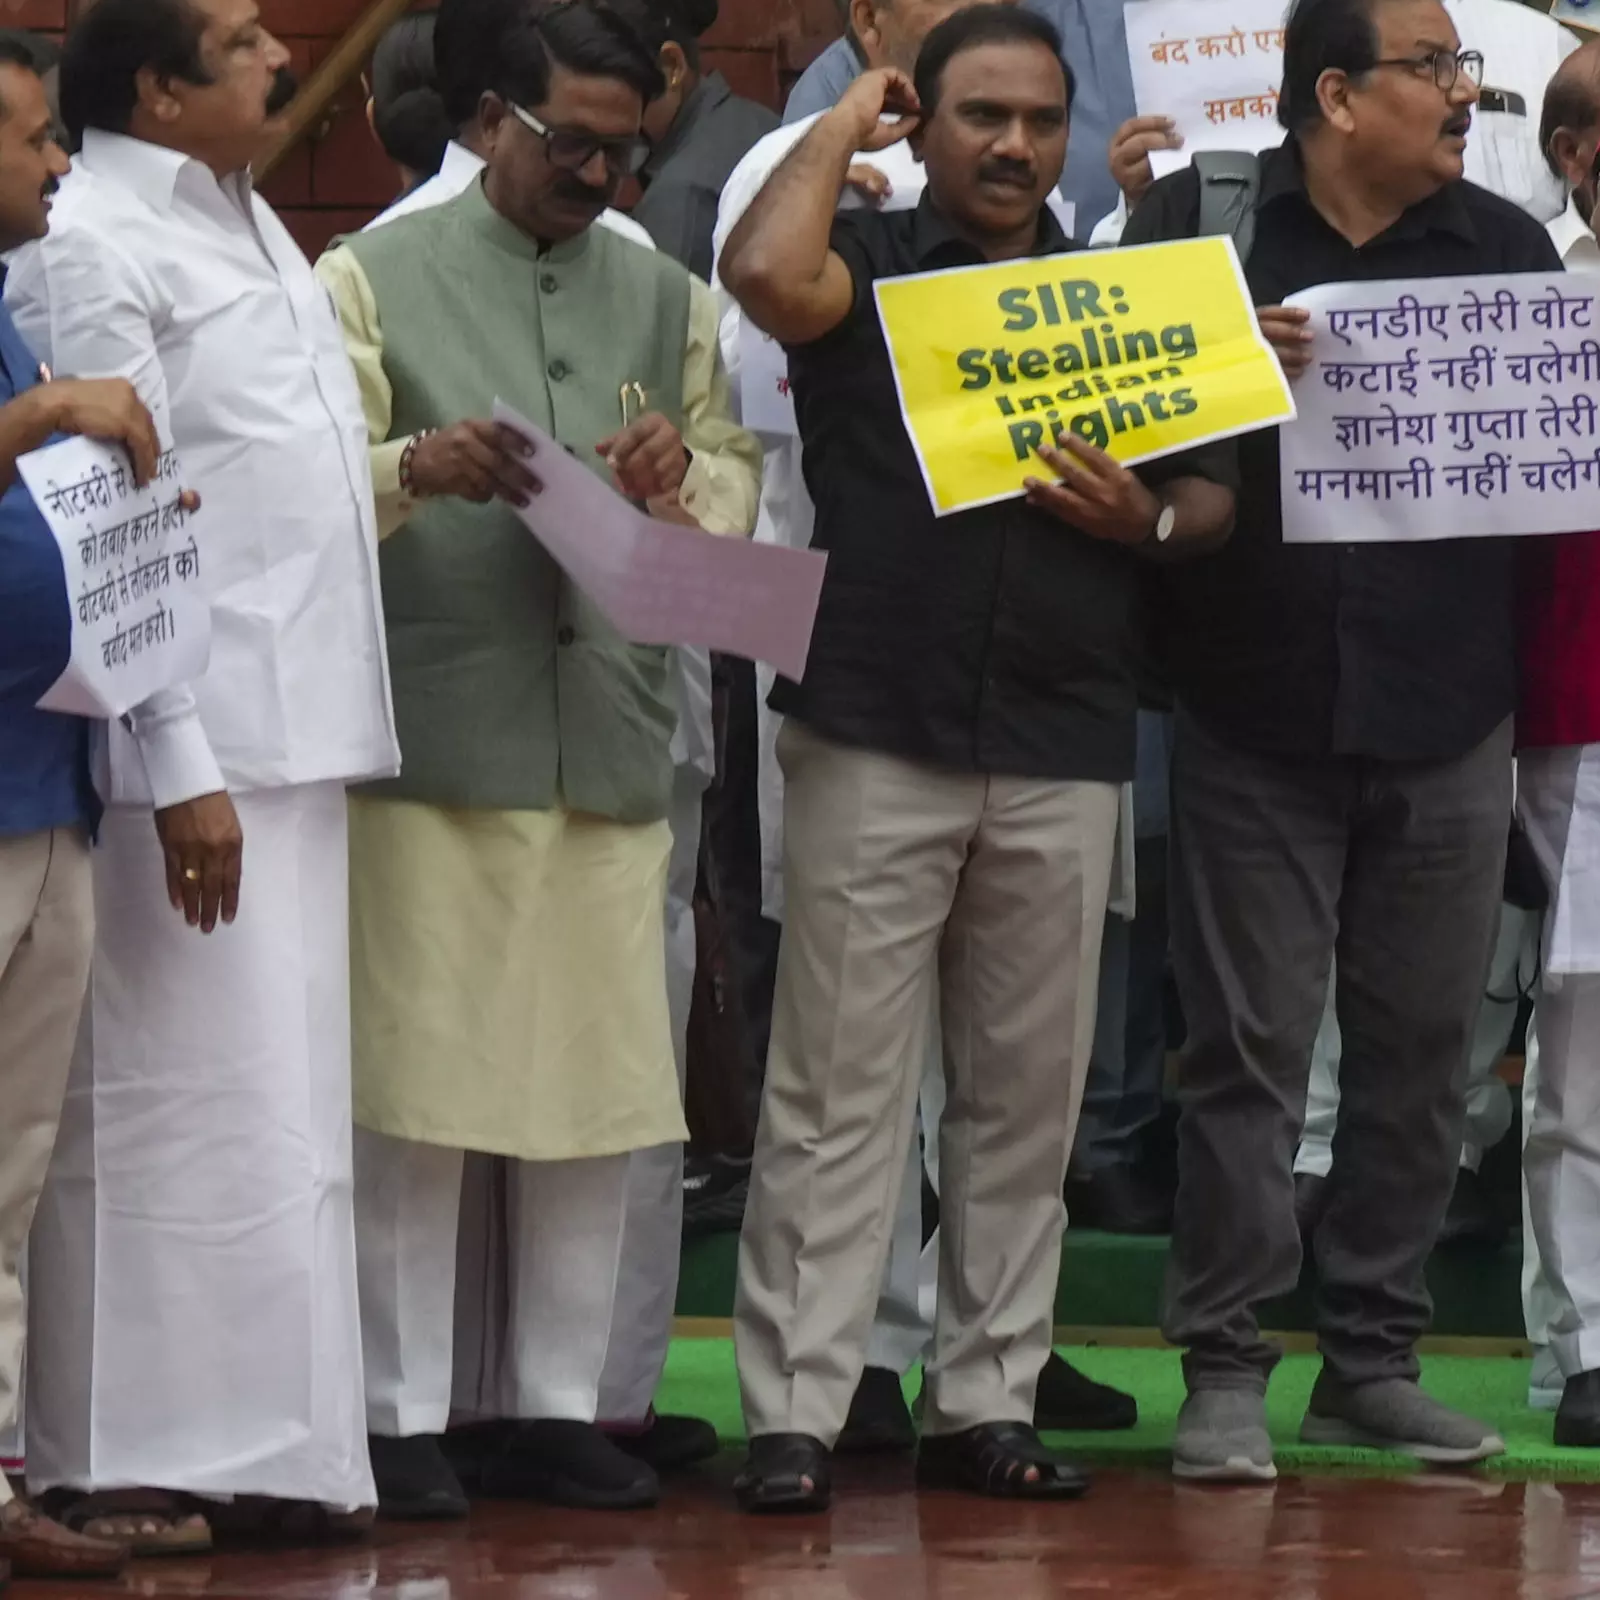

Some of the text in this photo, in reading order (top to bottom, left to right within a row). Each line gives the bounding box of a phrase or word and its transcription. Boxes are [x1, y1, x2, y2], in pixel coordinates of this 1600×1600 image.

[1150, 31, 1190, 65] बंद
[1196, 25, 1246, 59] करो
[997, 279, 1131, 332] SIR:
[1325, 286, 1594, 347] एनडीए तेरी वोट
[956, 322, 1198, 391] Stealing
[1320, 347, 1421, 397] कटाई
[1428, 344, 1497, 393] नहीं
[995, 365, 1183, 417] Indian
[1332, 394, 1598, 452] ज्ञानेश गुप्ता तेरी
[1294, 457, 1434, 501] मनमानी
[1442, 452, 1512, 499] नहीं
[173, 535, 200, 581] को
